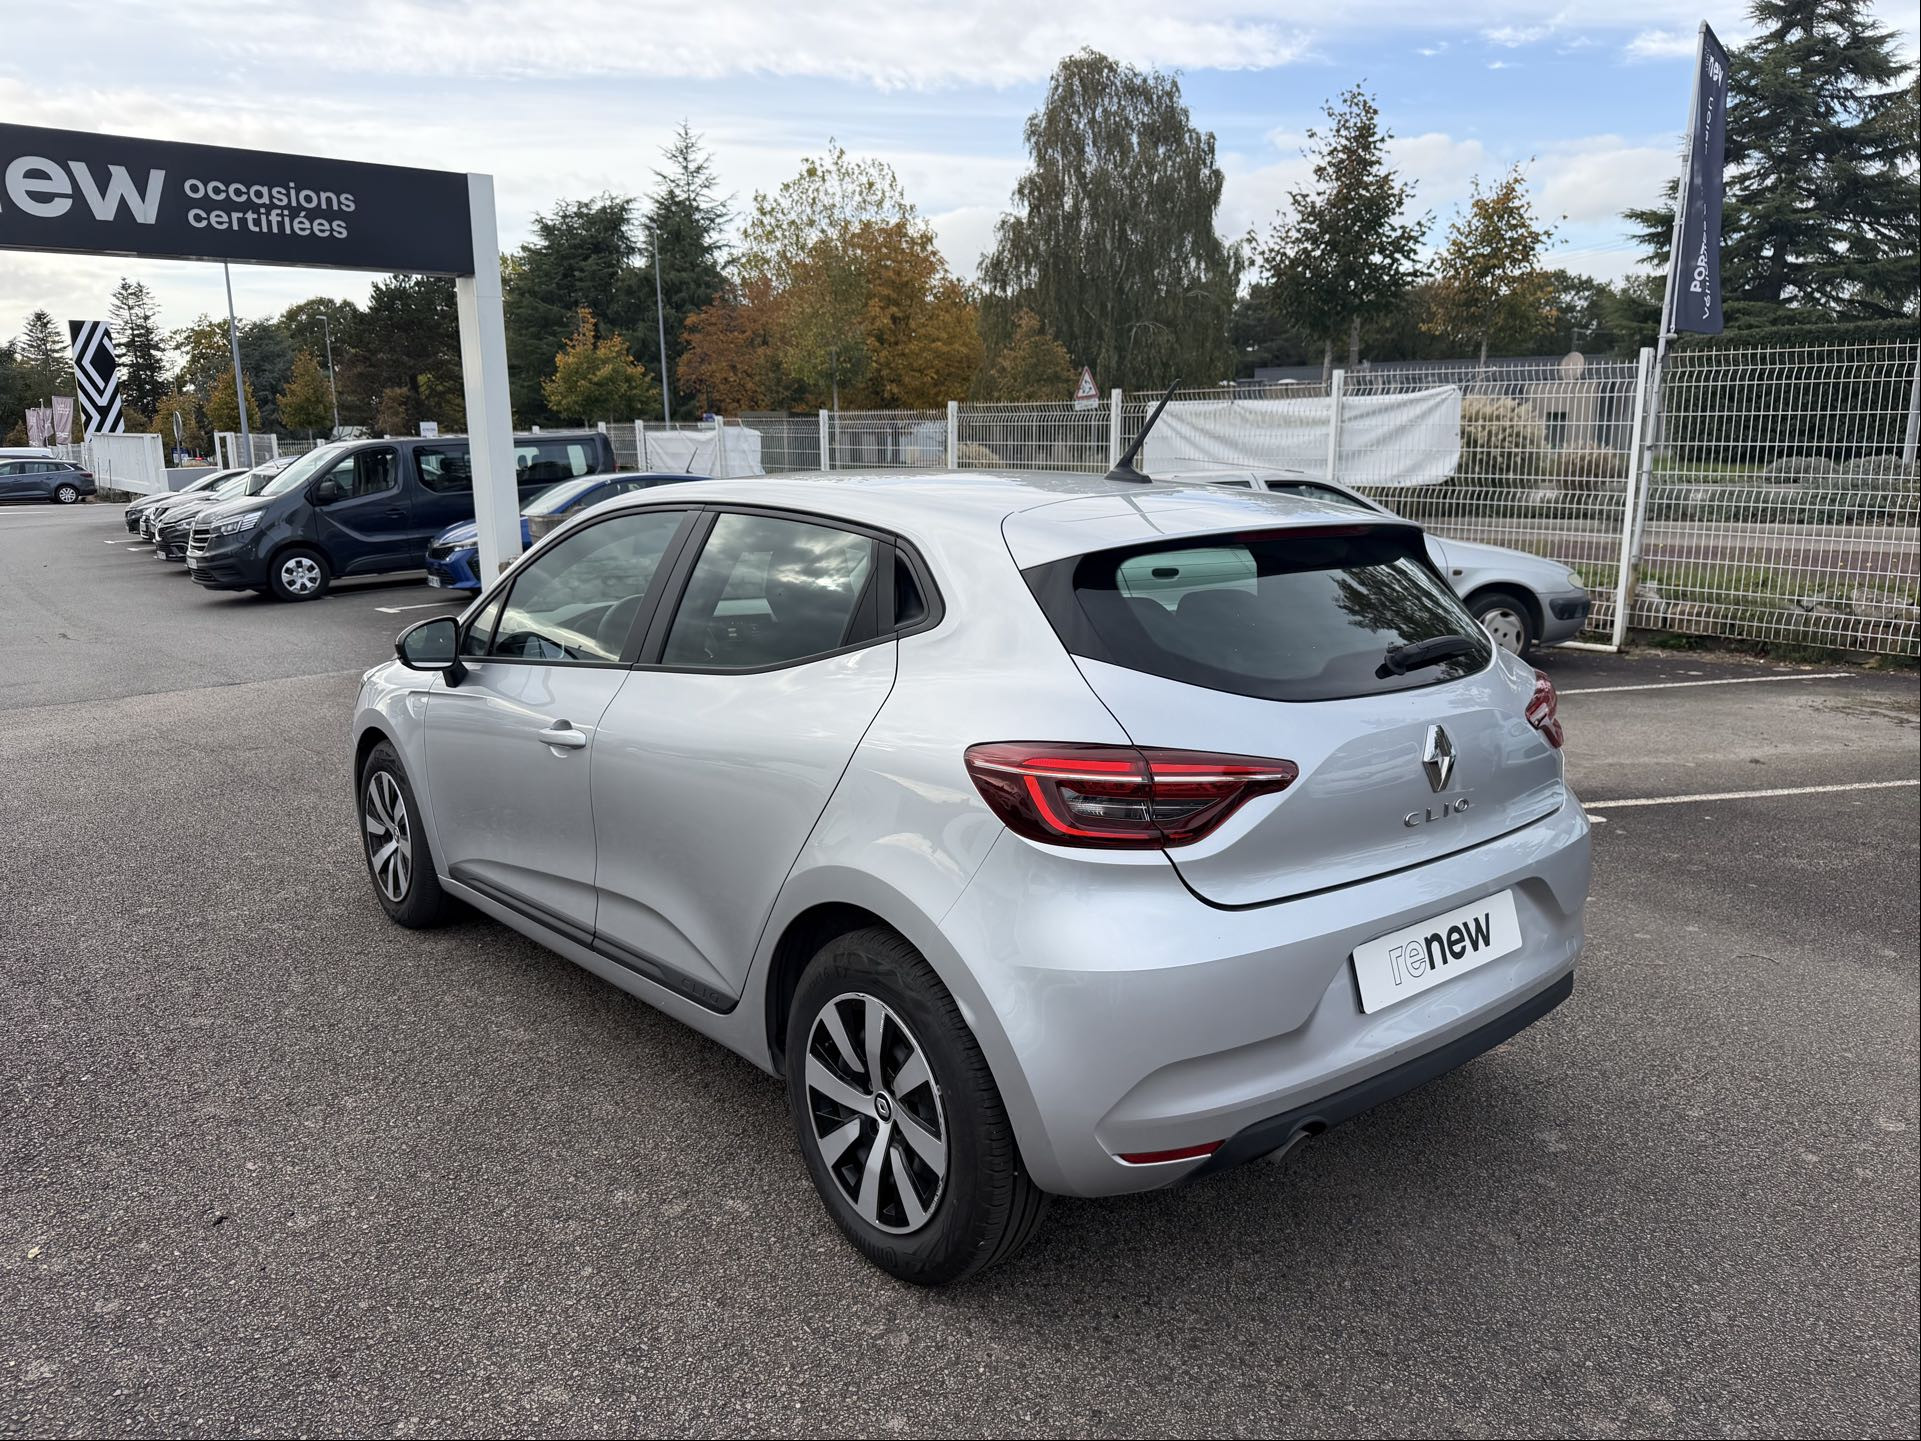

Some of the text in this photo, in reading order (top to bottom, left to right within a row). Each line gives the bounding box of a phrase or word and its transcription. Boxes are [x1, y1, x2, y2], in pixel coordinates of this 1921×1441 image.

[0, 156, 166, 225] ew
[183, 178, 356, 212] occasions
[187, 207, 348, 239] certifiées
[1404, 797, 1469, 827] CLIO
[1388, 912, 1491, 986] renew
